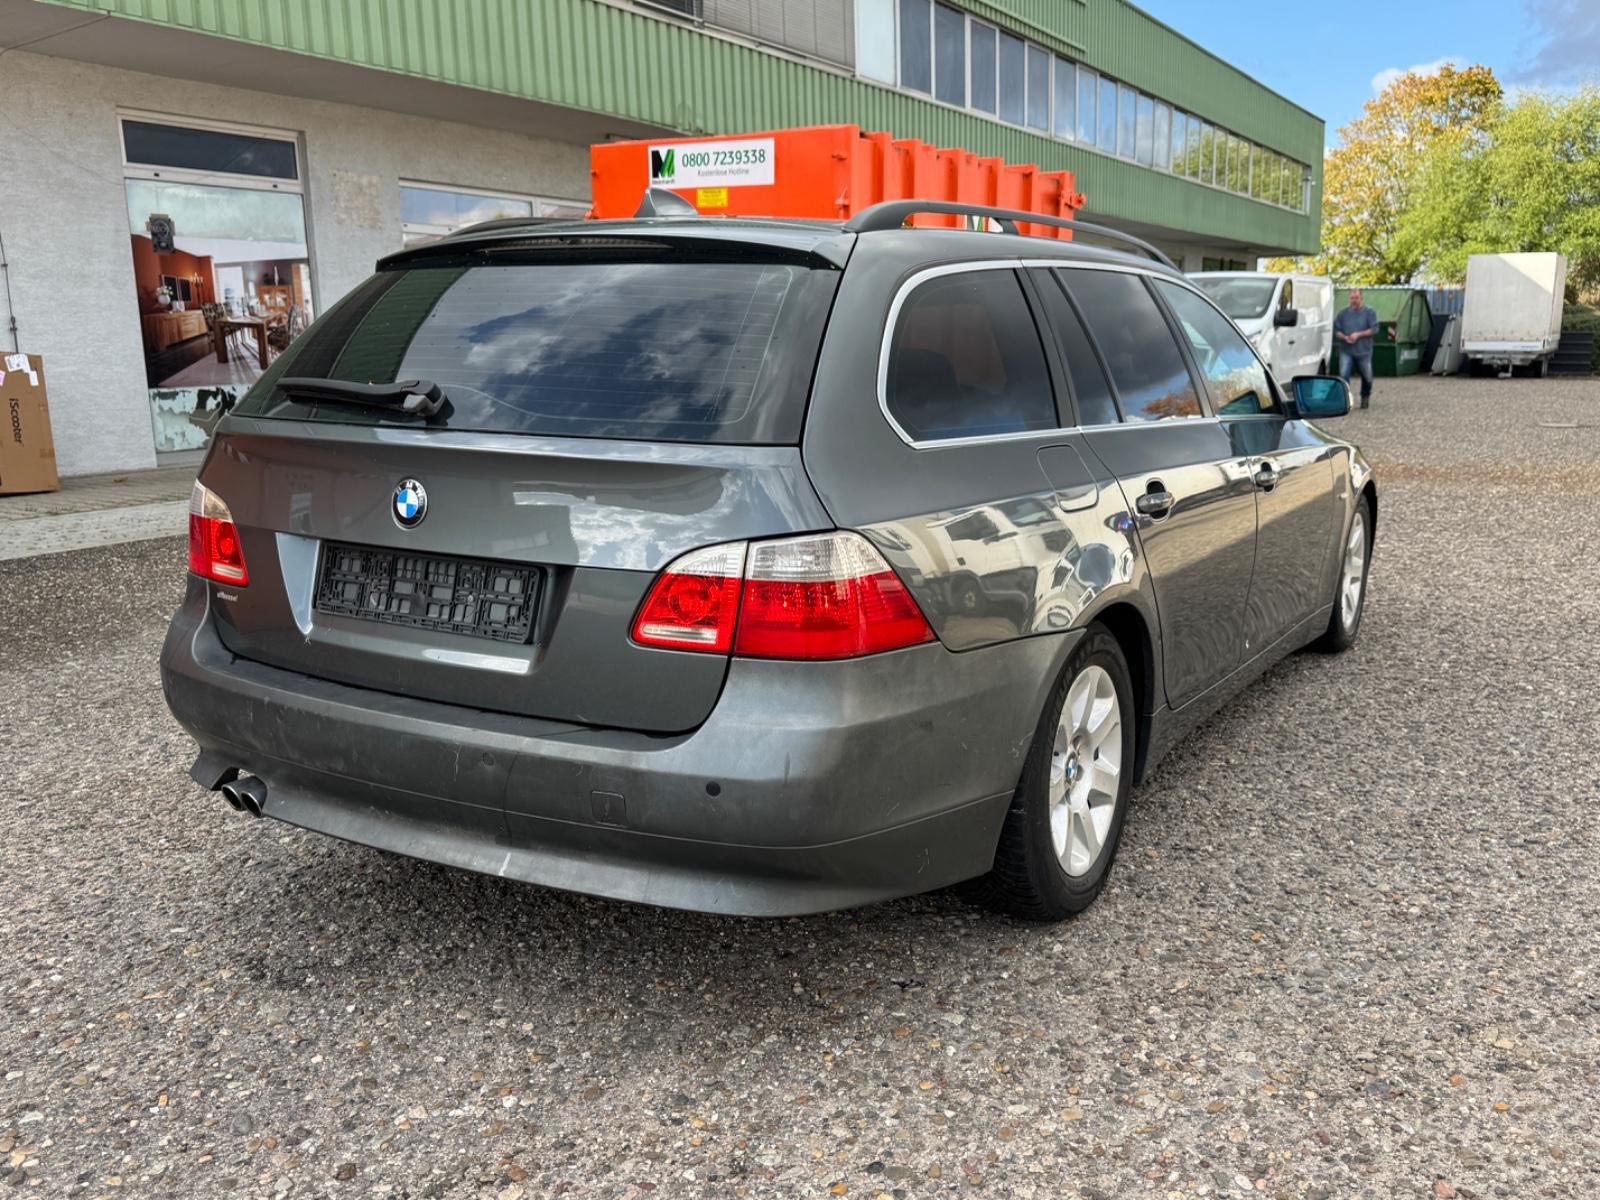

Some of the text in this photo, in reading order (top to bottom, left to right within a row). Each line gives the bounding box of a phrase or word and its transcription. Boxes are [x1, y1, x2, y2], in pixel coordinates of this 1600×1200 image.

[682, 149, 766, 168] 0800 7239338
[9, 398, 22, 444] iScooter
